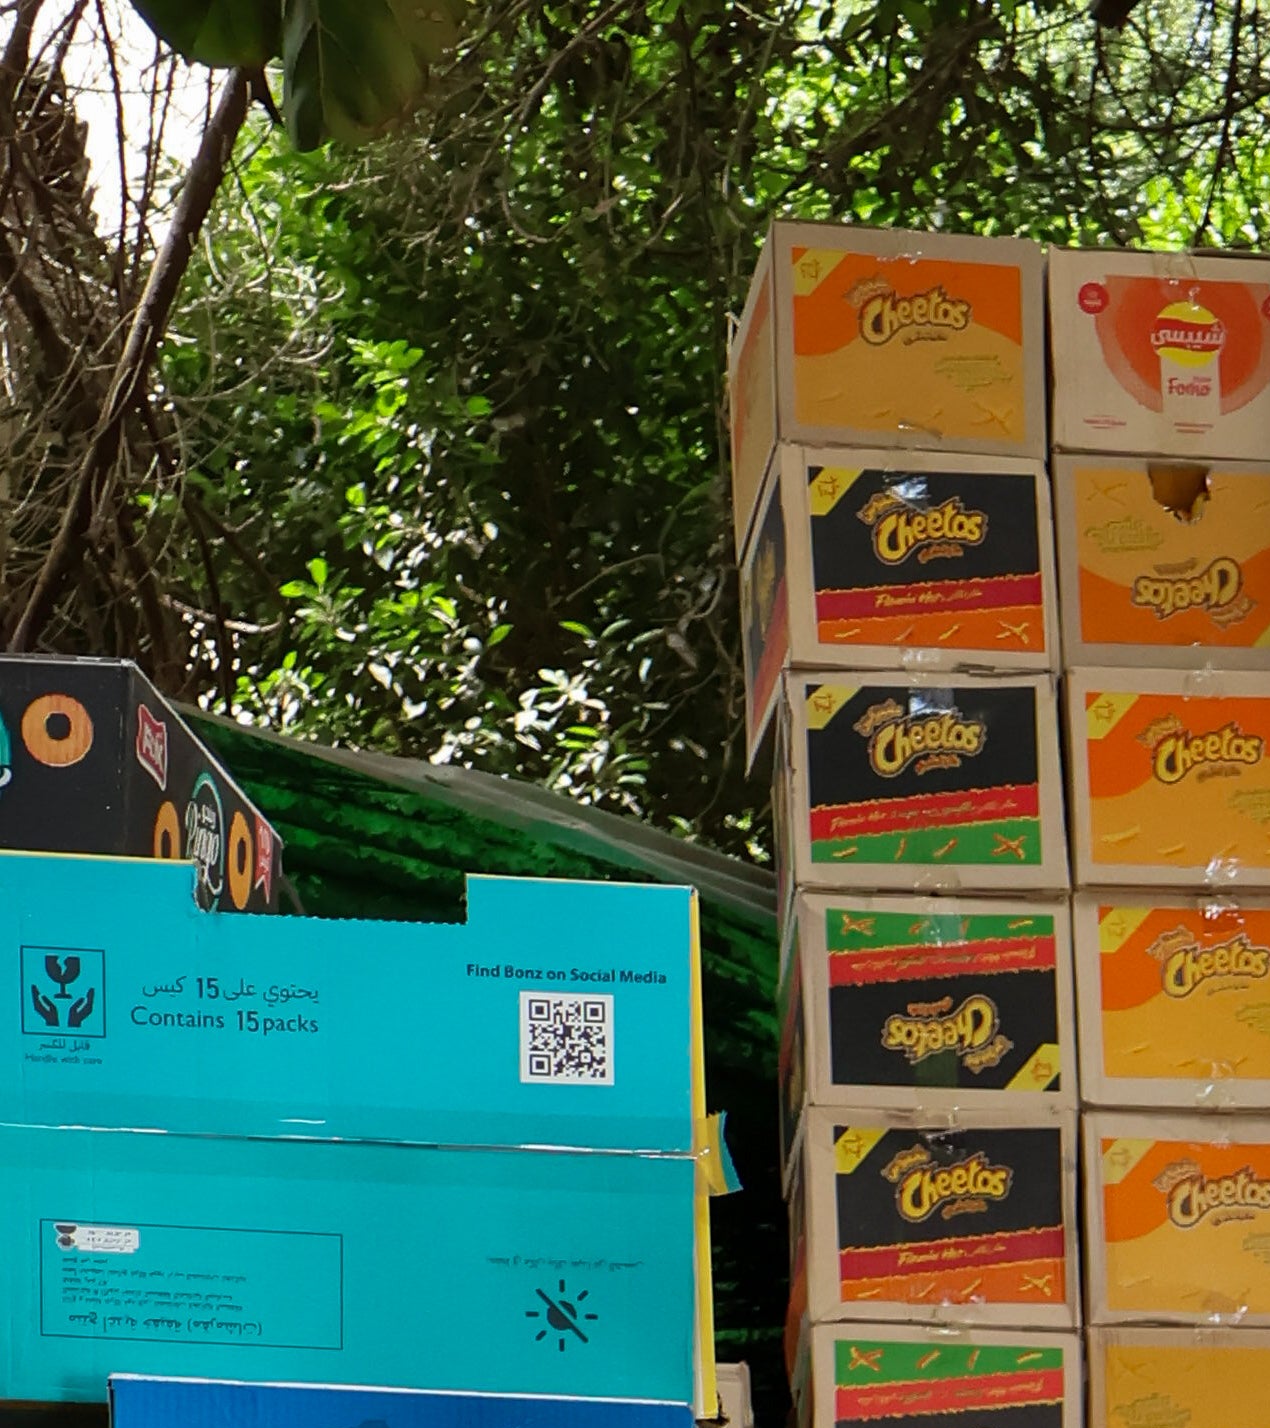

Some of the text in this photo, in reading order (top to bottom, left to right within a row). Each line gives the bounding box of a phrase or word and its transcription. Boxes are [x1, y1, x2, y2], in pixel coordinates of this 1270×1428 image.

[858, 286, 973, 348] Cheetos
[873, 494, 989, 565] Cheetos
[1132, 555, 1243, 622] Cheetos
[868, 708, 988, 778] Cheetos
[1153, 710, 1264, 785] Cheetos
[141, 975, 319, 1008] يحتوي على 15 كيس
[466, 963, 667, 985] Find Bonz on Social Media
[130, 1005, 319, 1036] Contains 15 packs
[897, 1153, 1014, 1224] Cheetos
